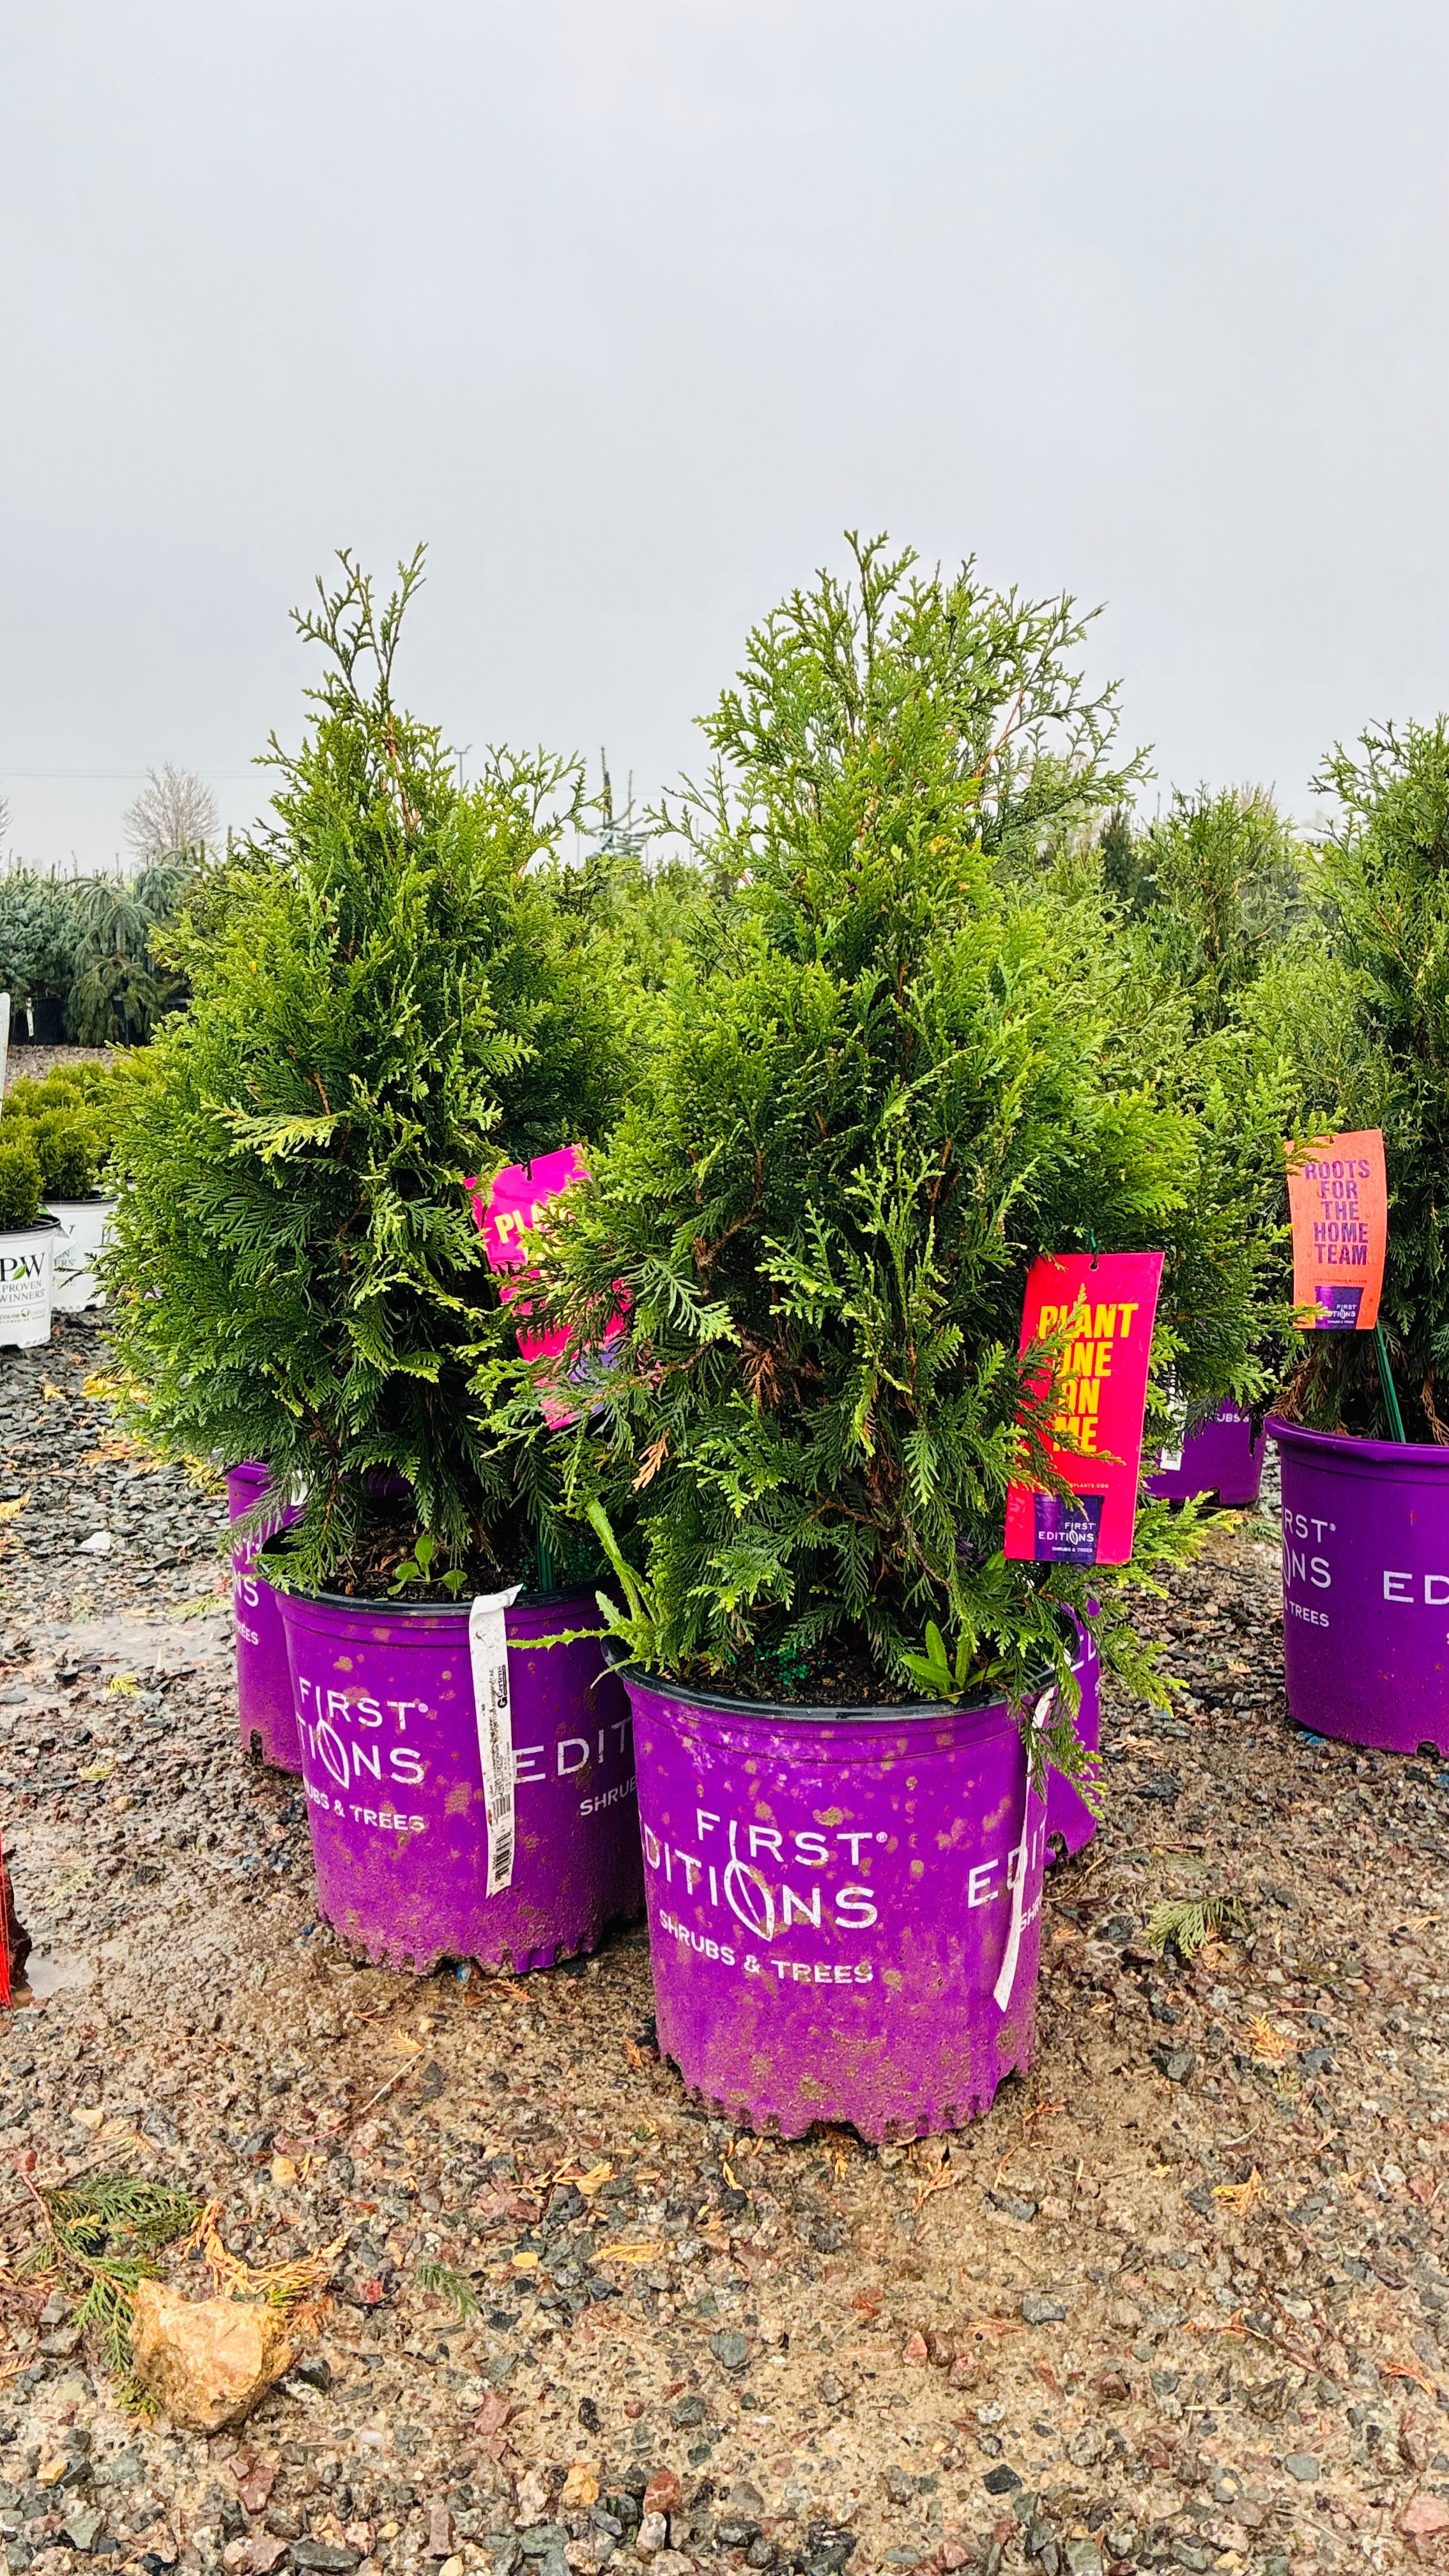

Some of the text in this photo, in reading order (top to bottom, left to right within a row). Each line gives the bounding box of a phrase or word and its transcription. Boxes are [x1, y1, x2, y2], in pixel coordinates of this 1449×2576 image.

[1305, 1159, 1370, 1180] ROOTS
[1320, 1180, 1358, 1199] FOR
[1321, 1200, 1360, 1221] THE
[1314, 1222, 1368, 1243] HOME
[1314, 1243, 1367, 1266] TEAM
[3, 1280, 42, 1294] PROVEN
[1038, 1303, 1139, 1340] PLANT
[1053, 1341, 1114, 1377] ONE
[1058, 1378, 1101, 1414] ON
[1052, 1416, 1099, 1452] ME
[1038, 1530, 1095, 1545] EDITIONS
[1289, 1600, 1330, 1627] TREES
[236, 1618, 259, 1646] REES
[334, 1798, 346, 1818] &
[349, 1804, 425, 1834] TREES
[639, 1809, 878, 1943] DITIONS
[659, 1908, 874, 1984] SHRUBS & TREES
